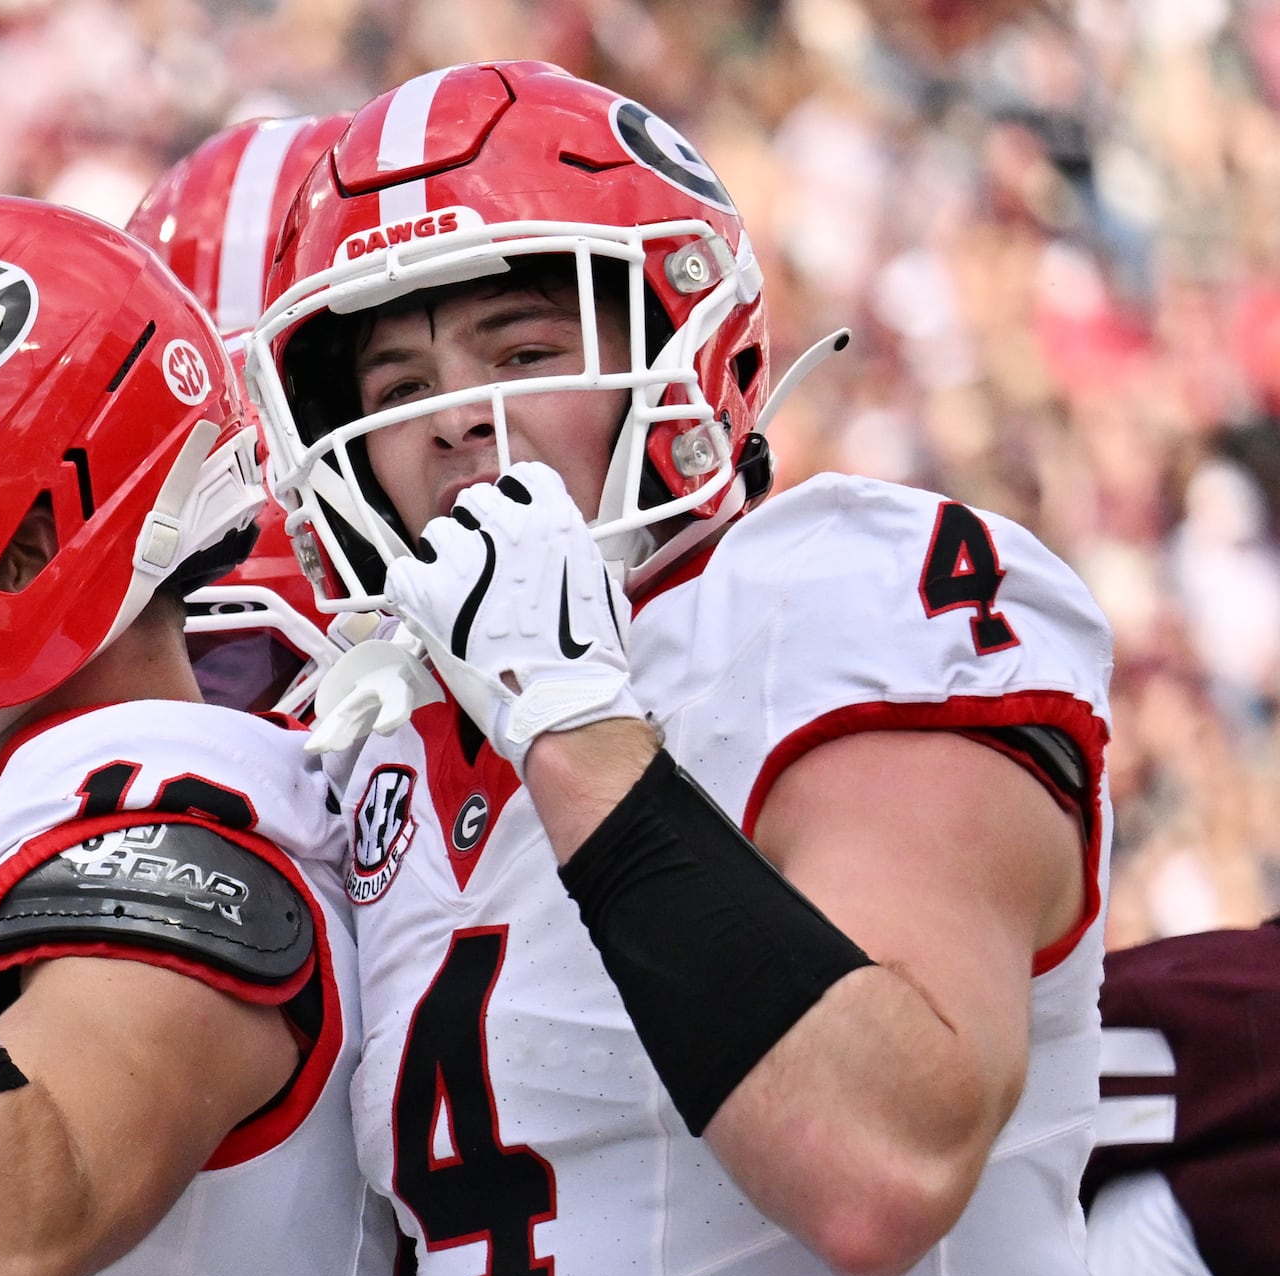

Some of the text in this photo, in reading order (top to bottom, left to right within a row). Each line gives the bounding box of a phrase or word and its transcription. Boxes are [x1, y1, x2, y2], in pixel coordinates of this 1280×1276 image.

[346, 212, 458, 260] DAWGS
[167, 344, 206, 399] SEC
[918, 499, 1022, 657] 4
[355, 771, 412, 867] SEC
[451, 793, 489, 852] G
[346, 845, 400, 900] GRADUATE
